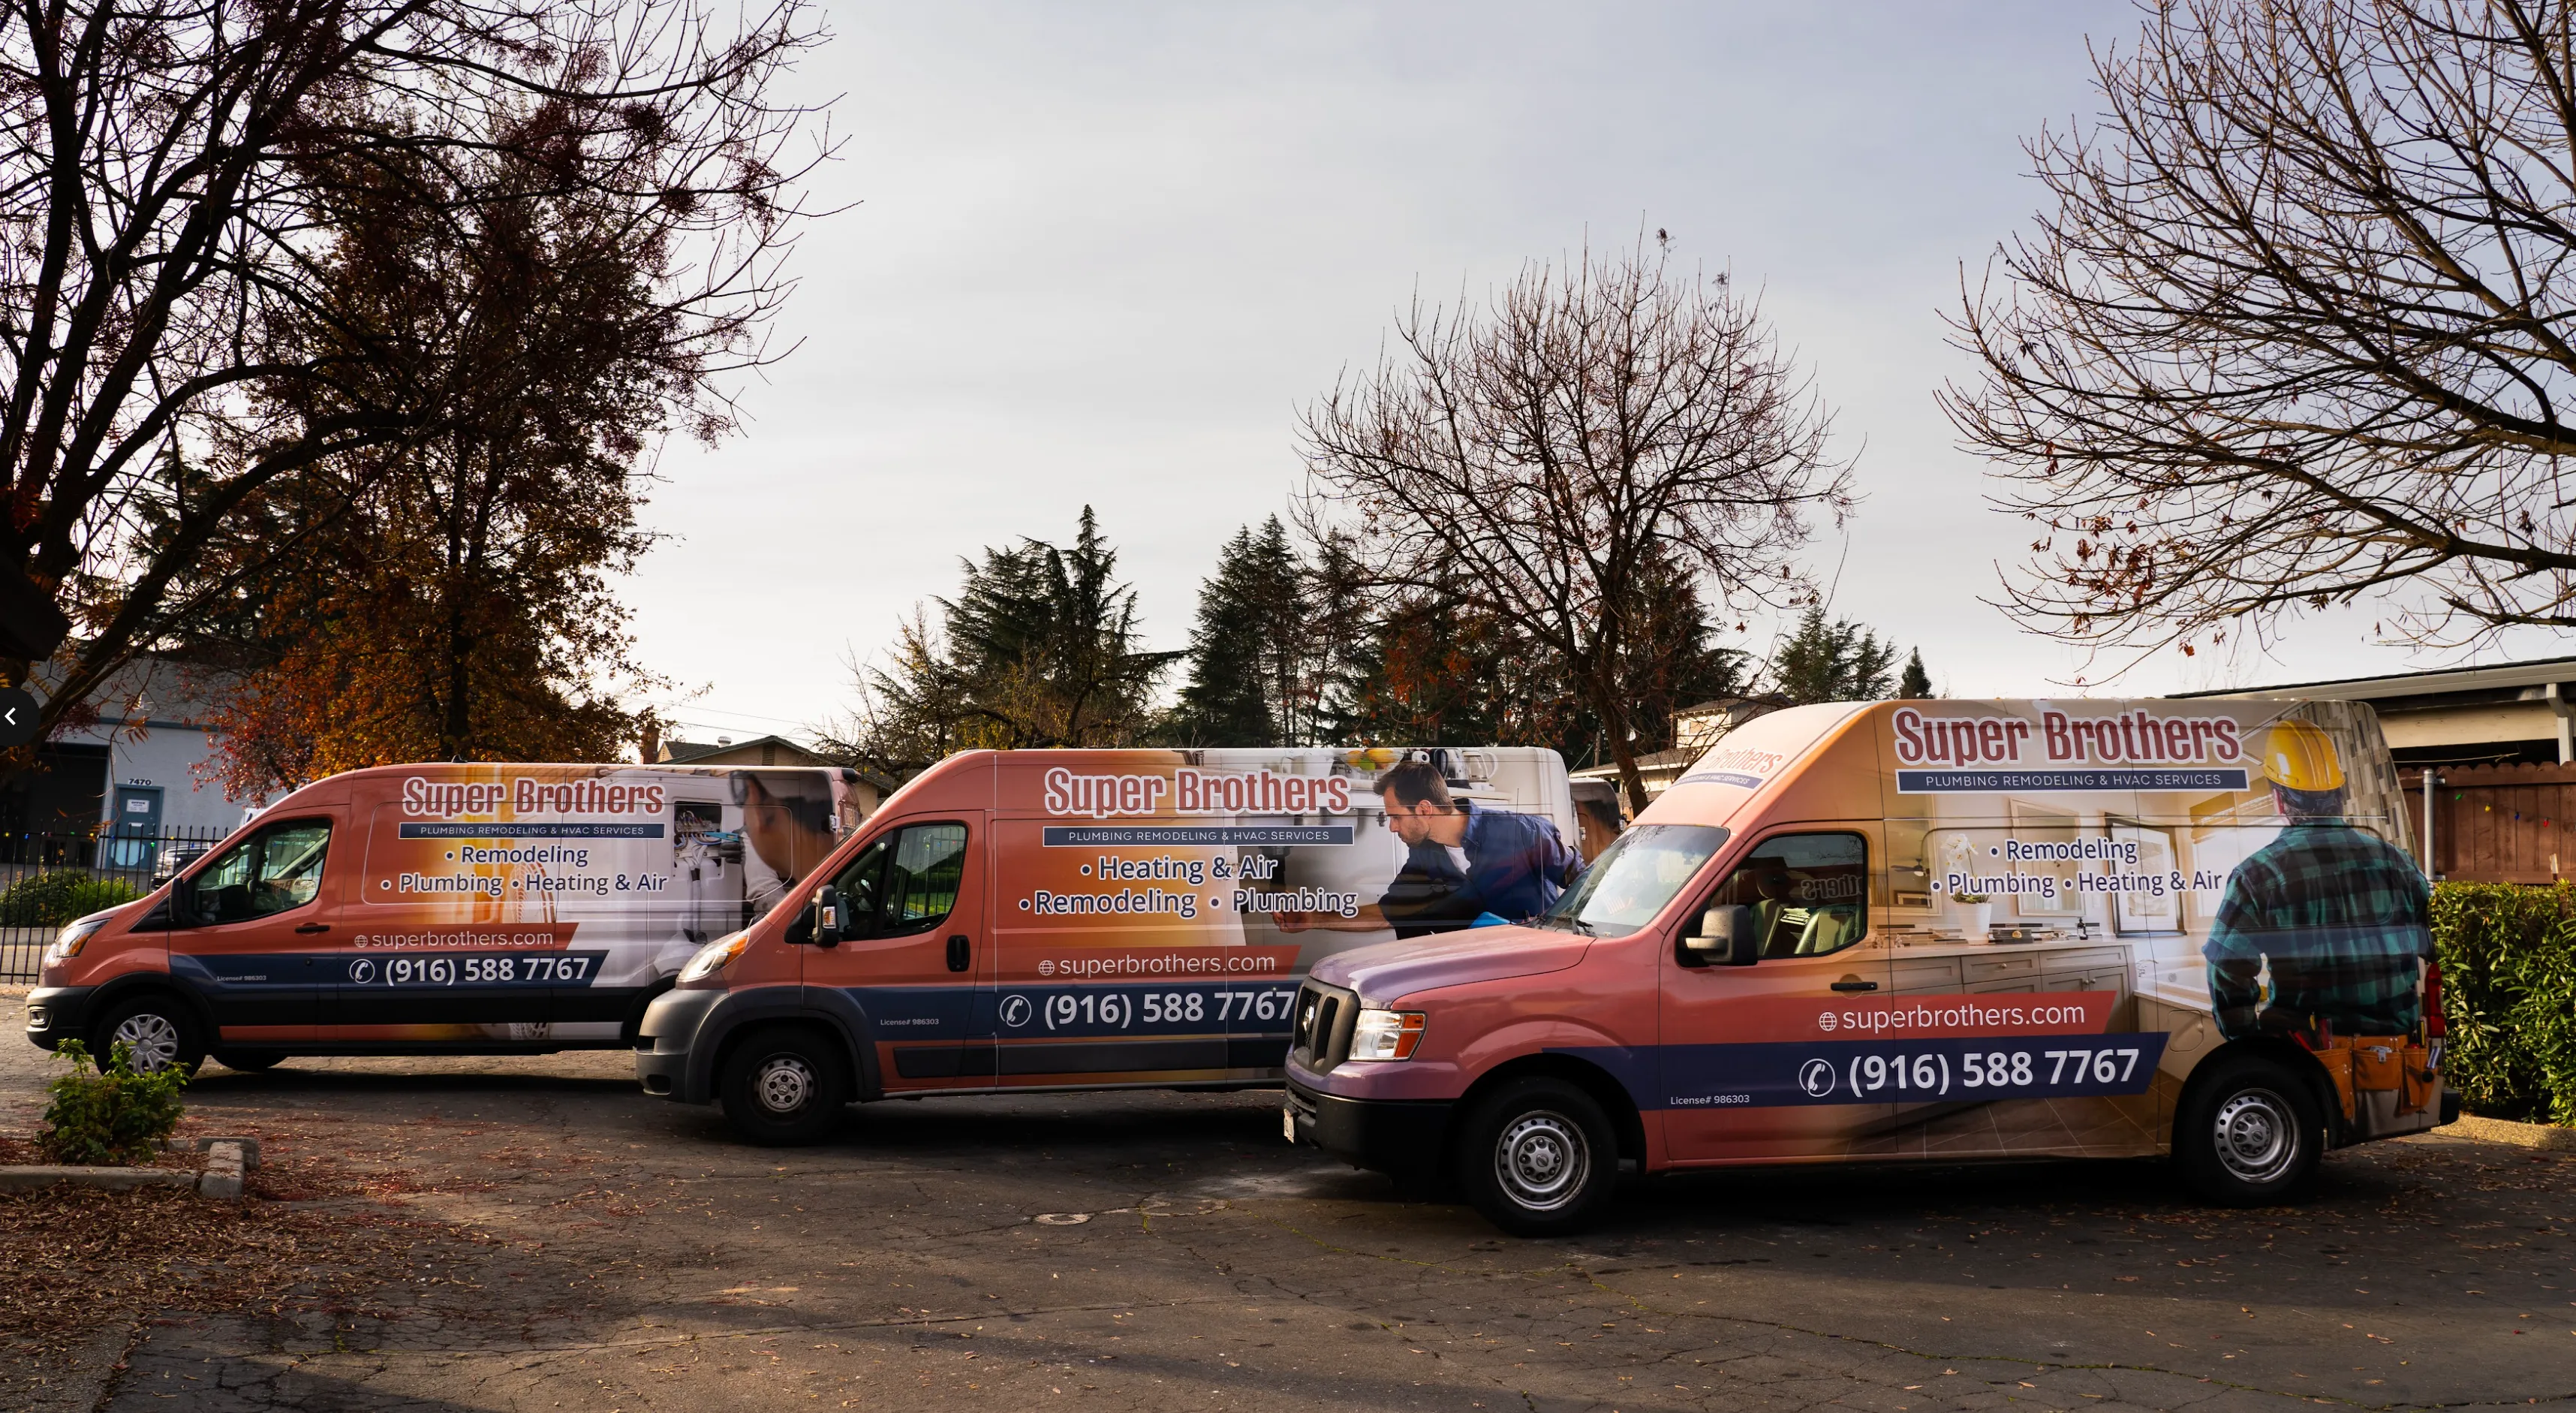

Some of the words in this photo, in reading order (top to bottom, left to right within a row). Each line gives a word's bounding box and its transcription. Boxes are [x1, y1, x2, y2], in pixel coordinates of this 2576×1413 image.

[1894, 709, 2029, 767] Super
[2042, 710, 2240, 761] Brothers
[1723, 774, 1751, 785] SERVICES
[1926, 775, 1998, 788] PLUMBING
[2003, 773, 2095, 787] REMODELING
[2099, 774, 2108, 785] &
[2113, 773, 2150, 785] HVAC
[2155, 773, 2222, 785] SERVICES
[403, 778, 505, 818] Super
[515, 778, 665, 815] Brothers
[1046, 770, 1166, 817] Super
[1178, 770, 1350, 812] Brothers
[420, 826, 474, 835] PLUMBING
[478, 826, 548, 835] REMODELING
[550, 826, 558, 835] &
[561, 826, 590, 835] HVAC
[593, 826, 645, 835] SERVICES
[1069, 831, 1133, 841] PLUMBING
[1136, 830, 1217, 841] REMODELING
[1221, 831, 1230, 841] &
[1233, 830, 1267, 840] HVAC
[1271, 830, 1330, 840] SERVICES
[461, 845, 589, 867] Remodeling
[2006, 836, 2138, 863] Remodeling
[1100, 856, 1204, 885] Heating
[1212, 857, 1232, 878] &
[1238, 855, 1277, 879] Air
[1949, 871, 2054, 897] Plumbing
[2078, 870, 2165, 896] Heating
[2170, 871, 2186, 890] &
[2192, 869, 2222, 890] Air
[400, 873, 503, 896] Plumbing
[525, 873, 609, 895] Heating
[615, 874, 630, 891] &
[636, 873, 668, 891] Air
[1035, 889, 1197, 919] Remodeling
[1232, 887, 1358, 918] Plumbing
[372, 930, 554, 950] superbrothers.com
[386, 958, 456, 987] (916)
[465, 958, 515, 982] 588
[522, 957, 590, 981] 7767
[1059, 954, 1276, 978] superbrothers.com
[1045, 994, 1132, 1030] (916)
[1142, 992, 1205, 1023] 588
[1213, 990, 1296, 1021] 7767
[1842, 1003, 2086, 1034] superbrothers.com
[1849, 1053, 1950, 1098] (916)
[1962, 1051, 2034, 1087] 588
[2044, 1048, 2140, 1085] 7767
[1670, 1095, 1712, 1105] License#
[1714, 1095, 1750, 1104] 986303
